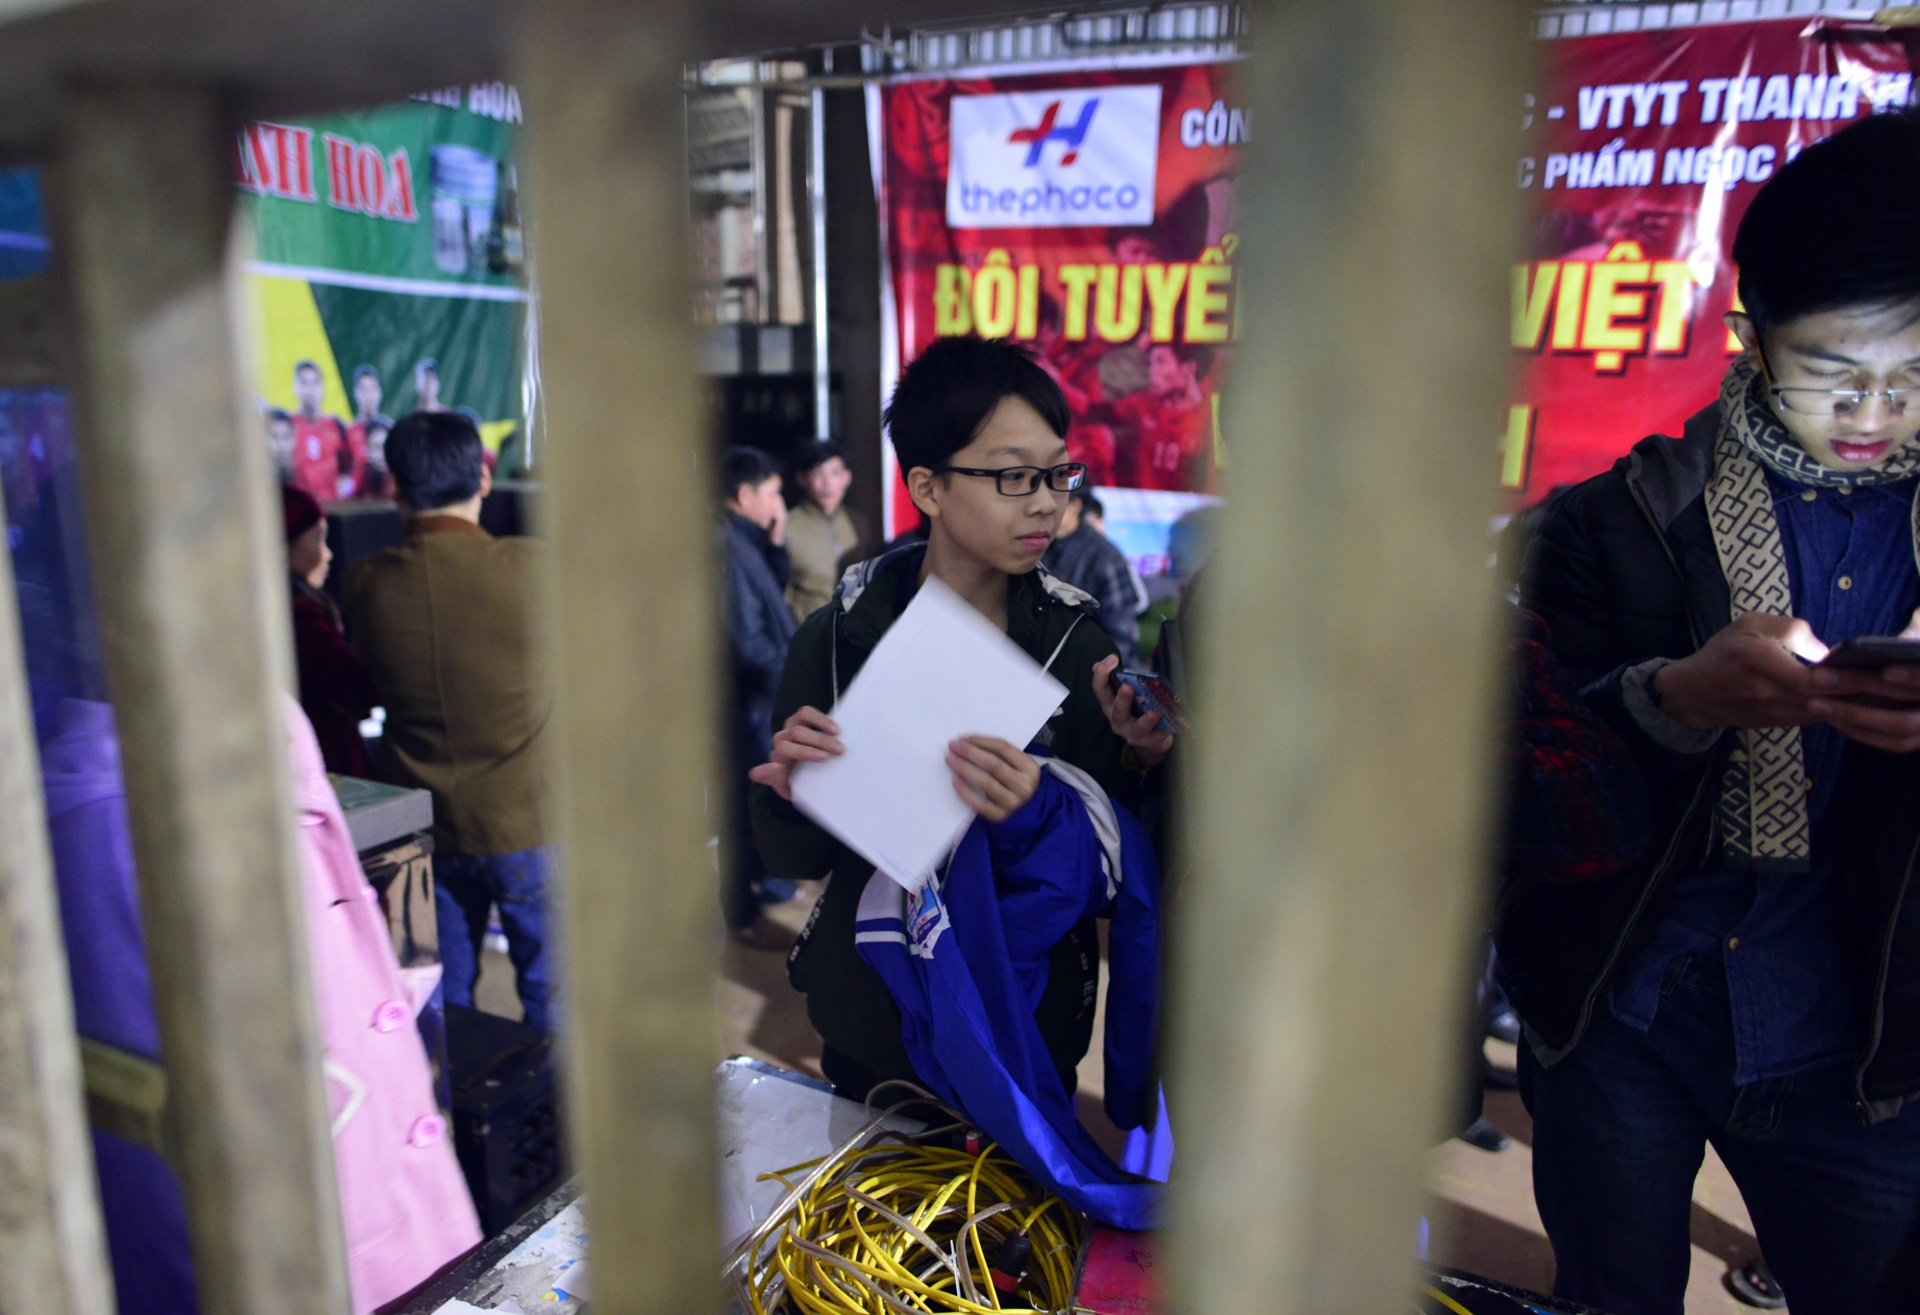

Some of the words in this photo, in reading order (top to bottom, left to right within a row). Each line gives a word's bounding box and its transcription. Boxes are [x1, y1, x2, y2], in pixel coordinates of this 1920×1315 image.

[1577, 82, 1687, 131] VTYT
[1699, 72, 1861, 125] THANH
[1661, 143, 1776, 192] NGỌC
[960, 179, 1140, 217] thephaco
[1058, 232, 1244, 343] TUYỂ
[1510, 241, 1698, 371] VIỆT
